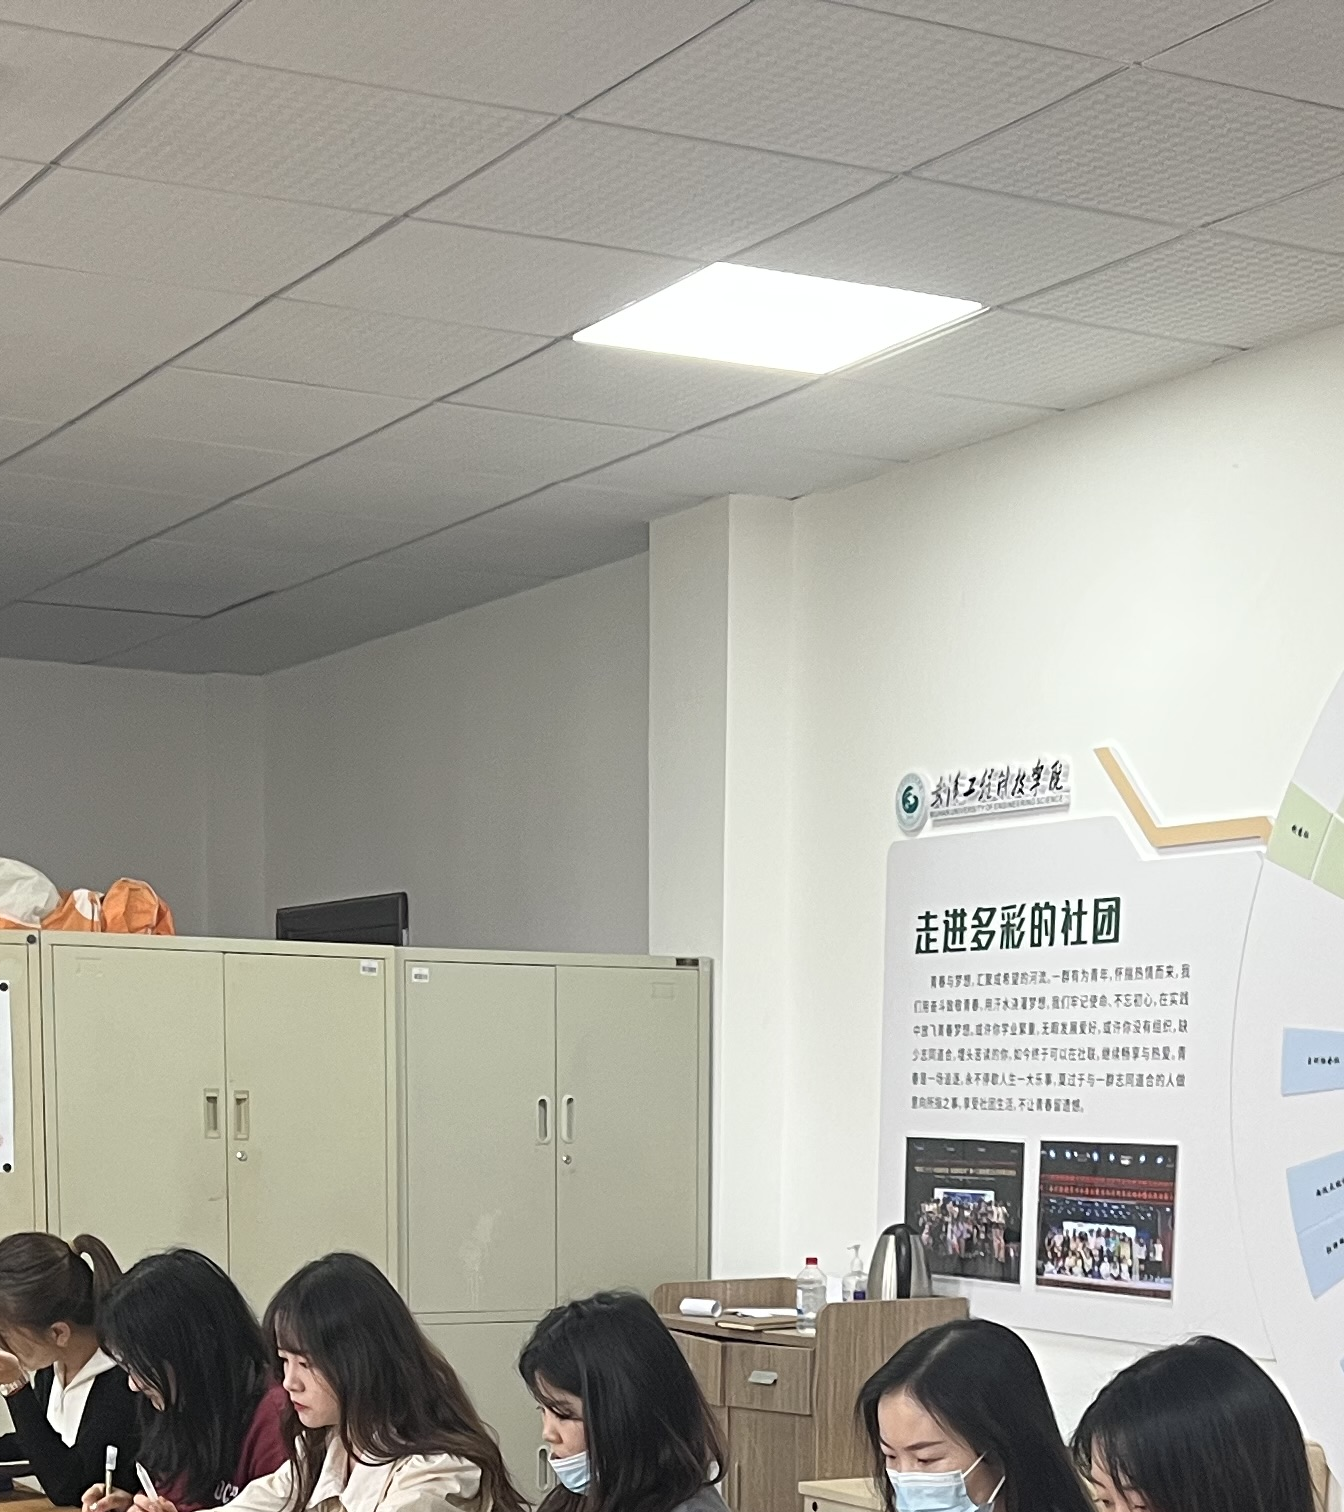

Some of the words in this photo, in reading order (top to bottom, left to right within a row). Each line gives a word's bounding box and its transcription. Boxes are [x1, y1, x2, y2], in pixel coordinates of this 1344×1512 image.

[915, 896, 1121, 955] 走进多彩的社团
